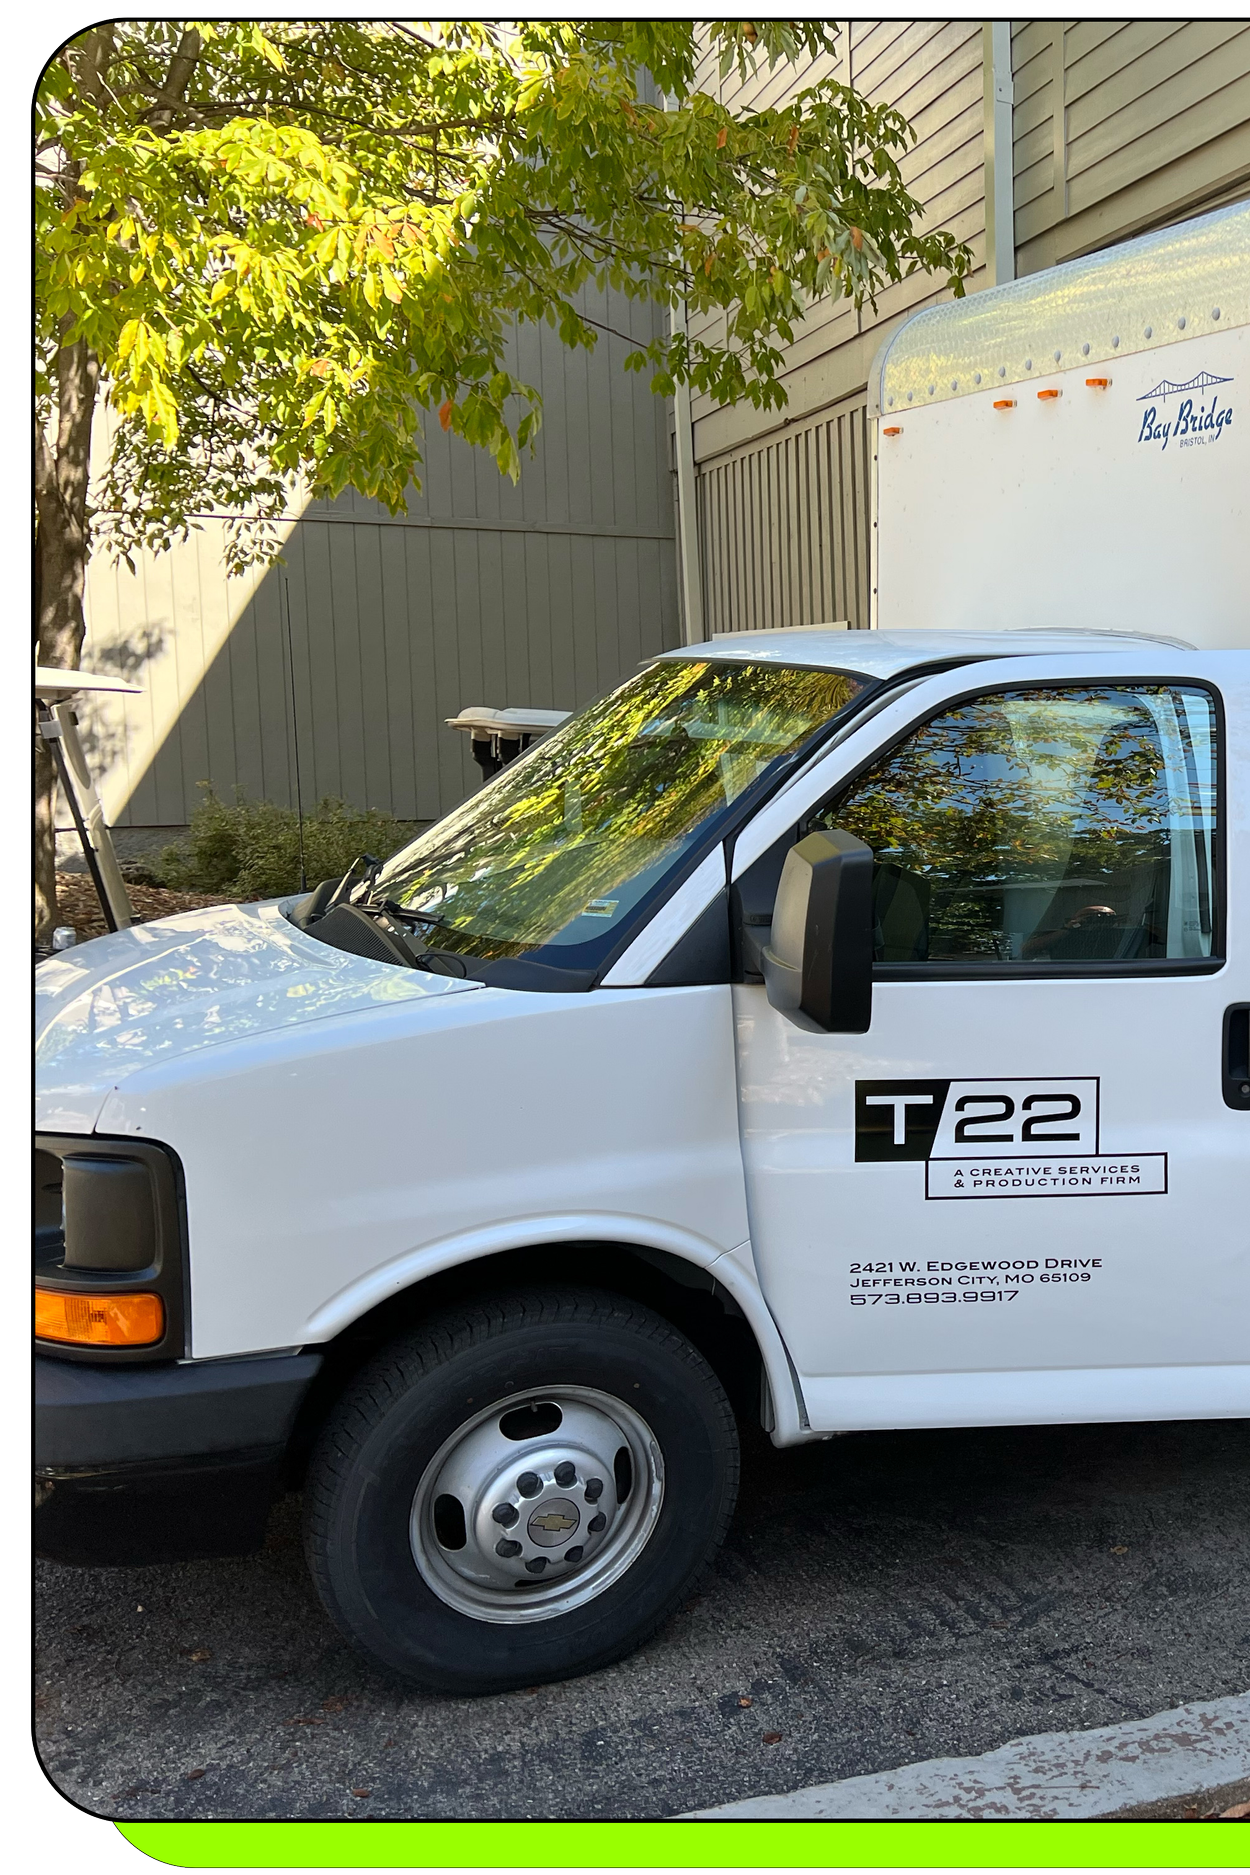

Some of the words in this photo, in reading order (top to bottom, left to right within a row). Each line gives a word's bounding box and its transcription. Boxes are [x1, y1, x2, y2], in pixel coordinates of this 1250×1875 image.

[1138, 406, 1172, 451] Bay
[1173, 396, 1233, 440] Bridge
[1208, 434, 1216, 443] IN
[954, 1168, 964, 1177] A
[970, 1166, 1052, 1176] CREATIVE
[1058, 1164, 1141, 1175] SERVICES
[954, 1179, 965, 1189] &
[973, 1177, 1093, 1188] PRODUCTION
[1100, 1175, 1141, 1185] FIRM
[849, 1262, 894, 1274] 2421
[899, 1261, 921, 1273] W.
[927, 1258, 1039, 1272] EDGEWOOD
[1045, 1257, 1103, 1270] DRIVE
[849, 1275, 953, 1288] JEFFERSON
[1005, 1272, 1035, 1284] MO
[1039, 1271, 1092, 1284] 65109
[850, 1290, 1020, 1306] 573.893.9917
